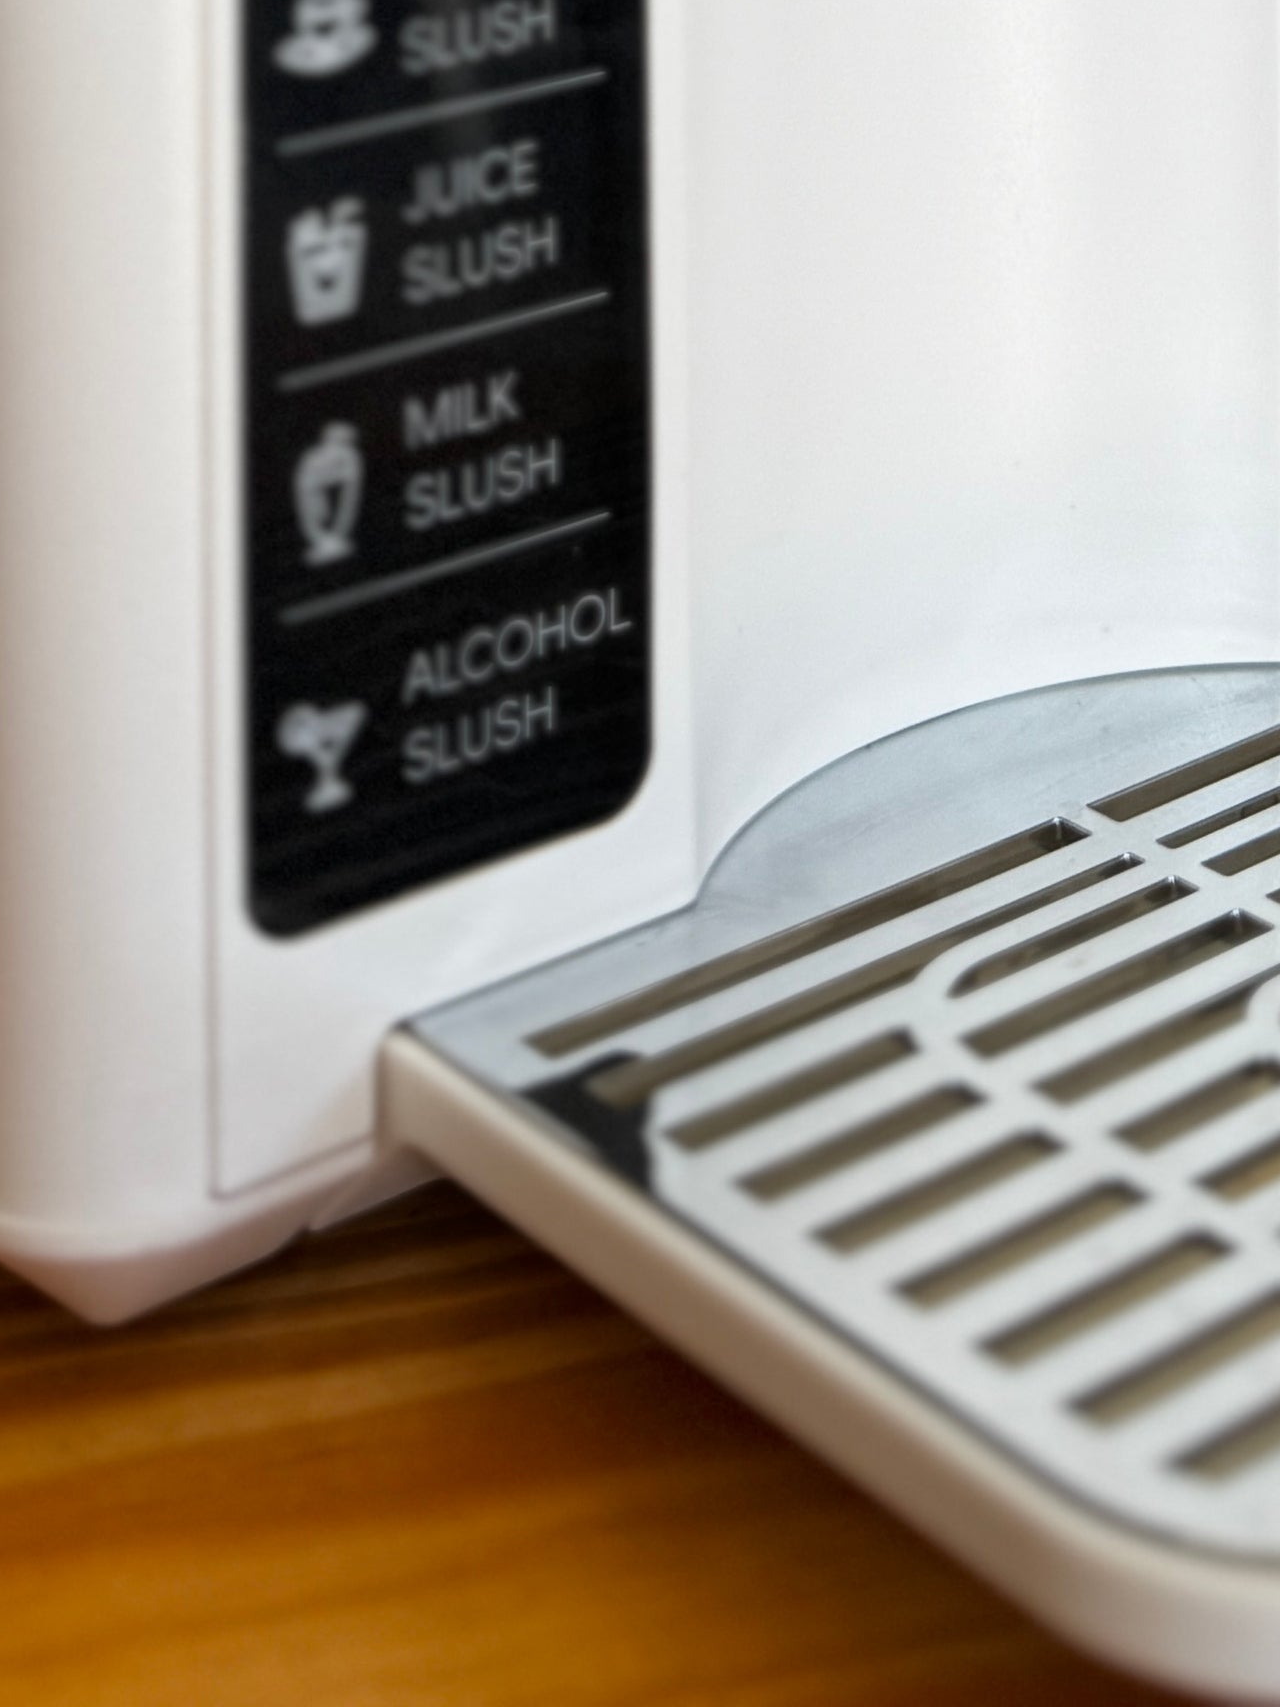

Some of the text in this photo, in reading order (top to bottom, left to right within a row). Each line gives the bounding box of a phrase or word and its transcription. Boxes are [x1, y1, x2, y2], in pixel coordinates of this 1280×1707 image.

[401, 139, 539, 225] JUICE
[401, 216, 560, 304] SLUSH
[402, 370, 521, 451] MILK
[404, 437, 561, 530] SLUSH
[401, 587, 633, 706] ALCOHOL
[402, 686, 557, 784] SLUSH
